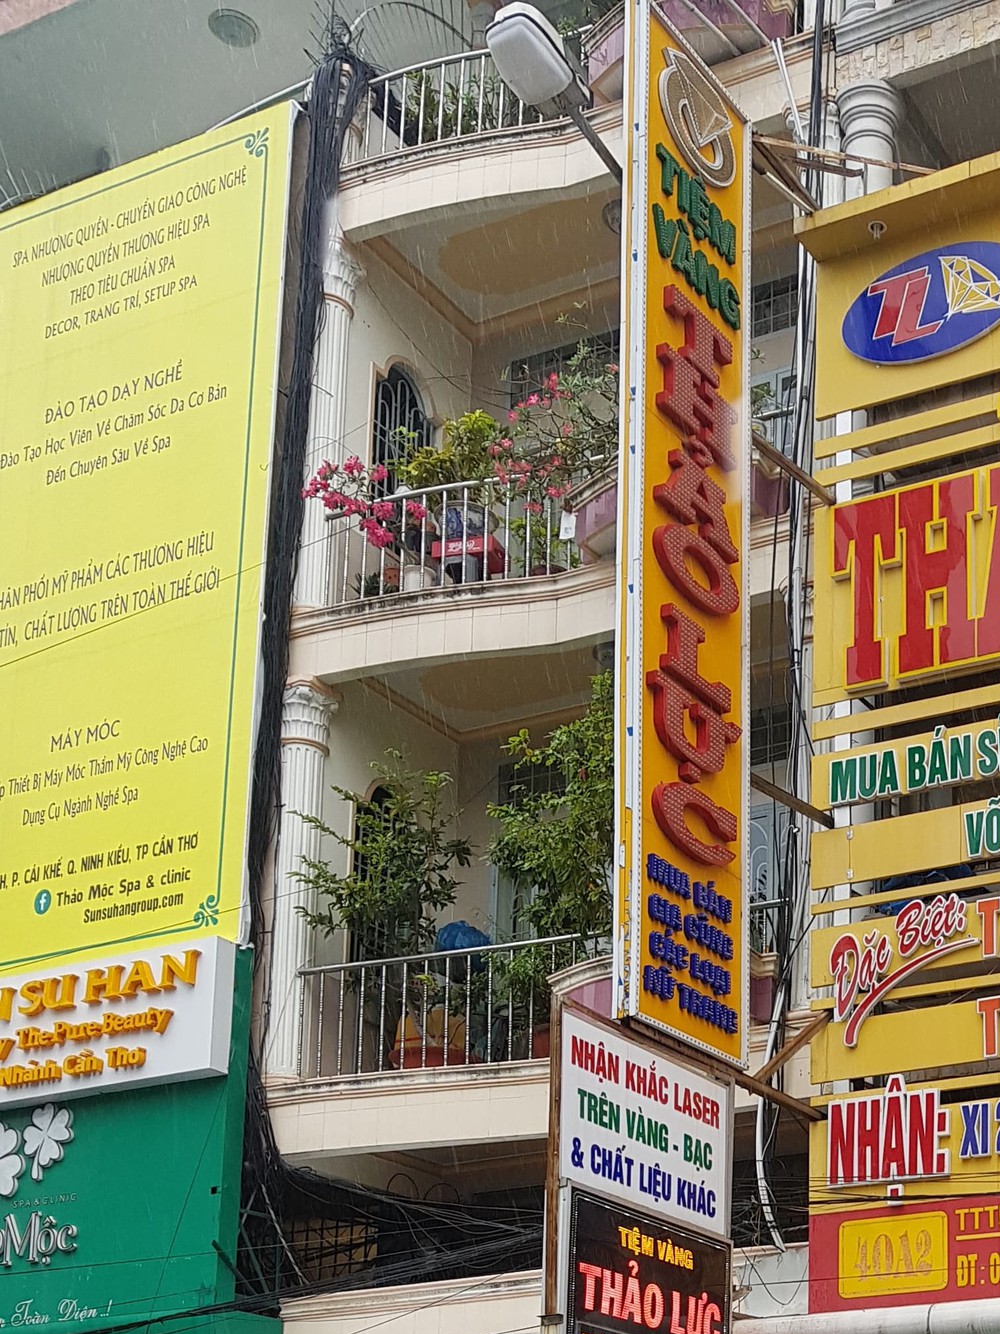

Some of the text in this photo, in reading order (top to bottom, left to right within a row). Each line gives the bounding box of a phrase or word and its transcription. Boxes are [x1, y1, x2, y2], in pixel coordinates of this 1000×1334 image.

[656, 143, 736, 266] TIỆM
[652, 203, 740, 330] VÀNG
[84, 274, 197, 326] TRANG SETUP SPA
[45, 377, 140, 424] ĐÀO TẠO DẠY
[70, 434, 171, 478] Chuyên Sâu Spa
[106, 531, 215, 580] CÁC THƯƠNG HIỆU
[646, 283, 744, 869] THẢO LỰC
[50, 718, 120, 753] MÁY MÓC
[828, 746, 900, 807] MUA
[906, 724, 974, 794] BÁN
[81, 844, 149, 873] NINH TP
[57, 867, 191, 907] Thảo Mộc Spa clinic
[83, 892, 184, 924] Sunsuhangroup.com
[828, 929, 893, 1023] Đặc
[52, 1021, 102, 1044] Pure
[102, 1007, 175, 1035] Beauty
[571, 1034, 720, 1130] NHẬN KHẮC LASER
[577, 1087, 713, 1173] TRÊN VÀNG BẠC
[826, 1073, 952, 1205] NHẬN:
[957, 1099, 992, 1160] XI
[571, 1136, 717, 1219] & CHẤT LIỆU KHÁC
[617, 1225, 694, 1271] TIỆM VÀNG
[854, 1229, 932, 1282] 40A2
[578, 1259, 666, 1331] THẢO
